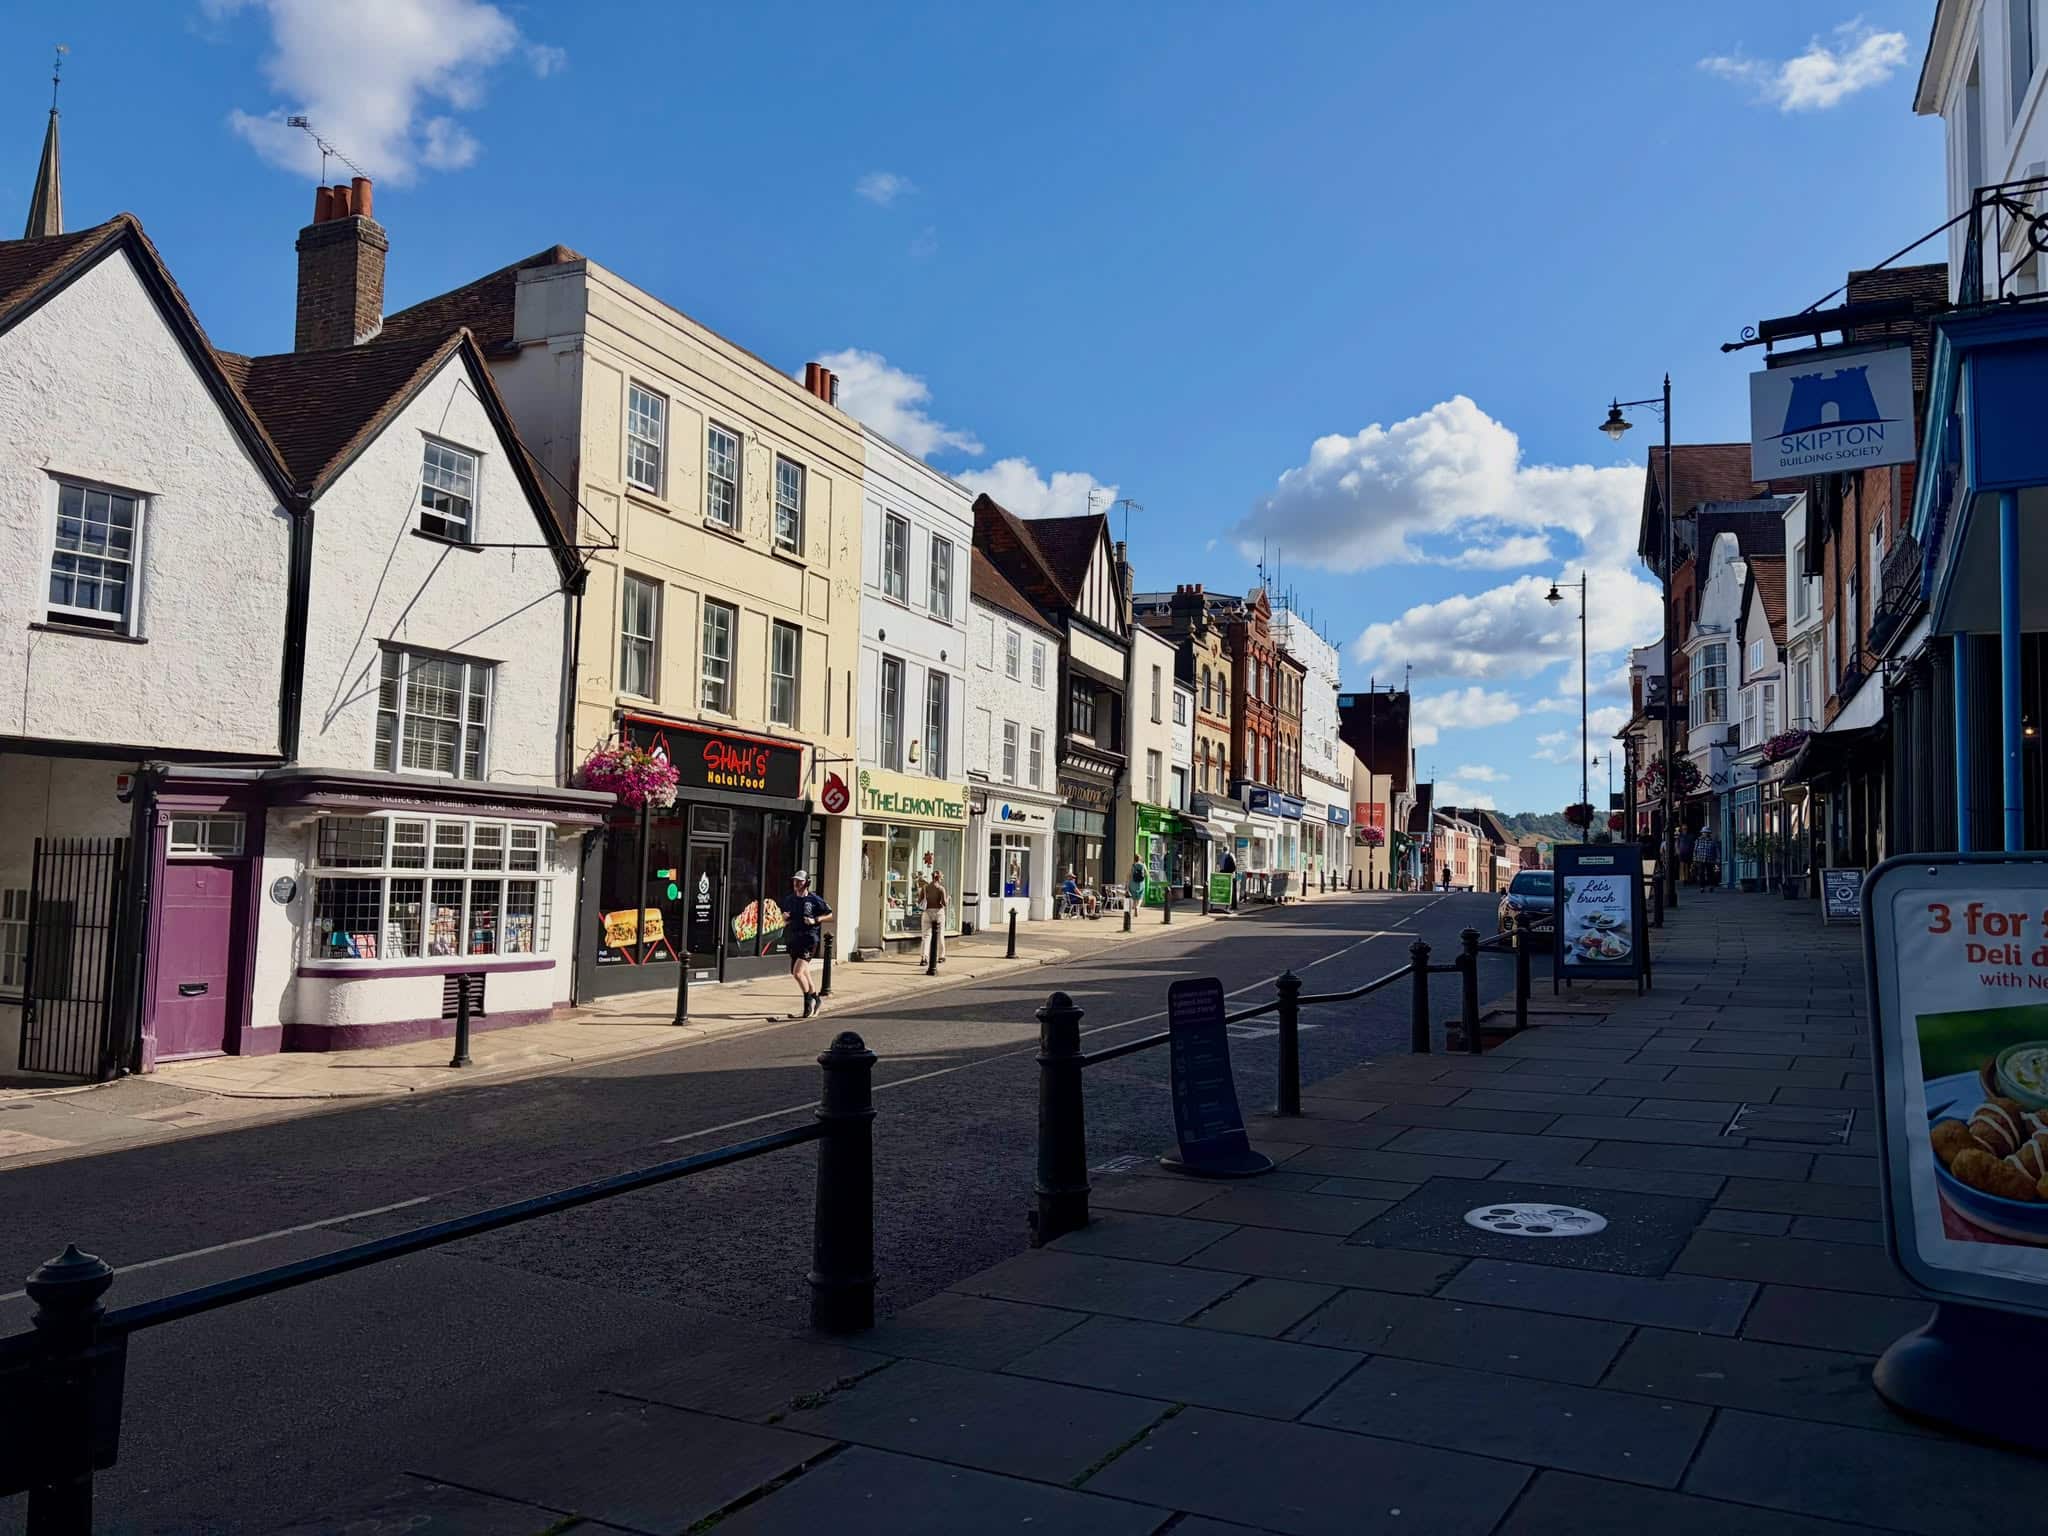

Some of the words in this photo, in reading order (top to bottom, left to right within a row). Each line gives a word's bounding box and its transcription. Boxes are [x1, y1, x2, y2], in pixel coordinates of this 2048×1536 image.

[1780, 423, 1885, 455] SKIPTON
[1780, 451, 1833, 468] BUILDING
[1835, 446, 1884, 460] SOCIETY
[707, 771, 738, 787] Halal
[740, 775, 765, 790] Food
[1582, 879, 1612, 892] Let's
[1576, 891, 1617, 904] brunch
[1927, 903, 1952, 934] 3
[1964, 902, 2029, 937] for
[1966, 943, 2023, 966] Deli
[1980, 971, 2023, 989] with
